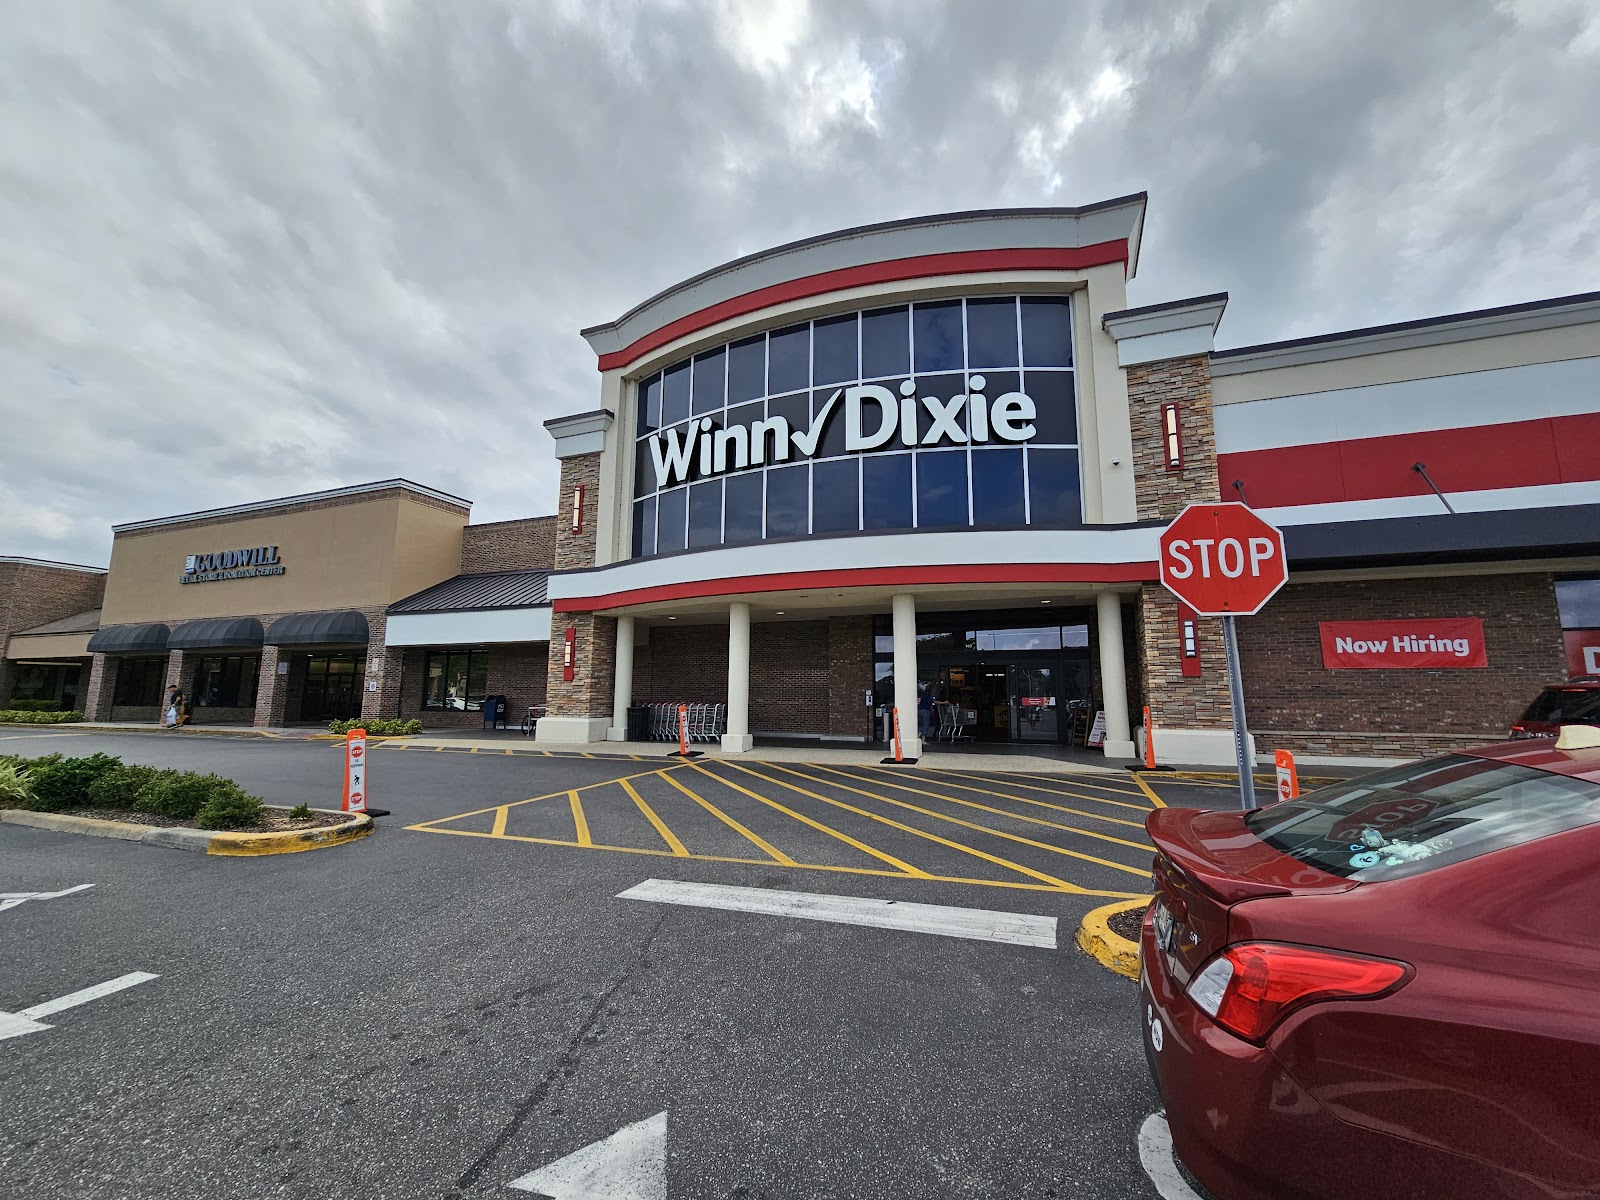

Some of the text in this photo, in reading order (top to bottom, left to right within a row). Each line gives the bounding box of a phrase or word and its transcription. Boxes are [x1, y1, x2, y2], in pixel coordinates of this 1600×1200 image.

[648, 374, 1037, 487] Winn Dixie
[195, 546, 280, 572] GOODWILL
[1168, 537, 1275, 579] STOP
[256, 566, 284, 577] CENTER
[1335, 634, 1470, 657] Now Hiring
